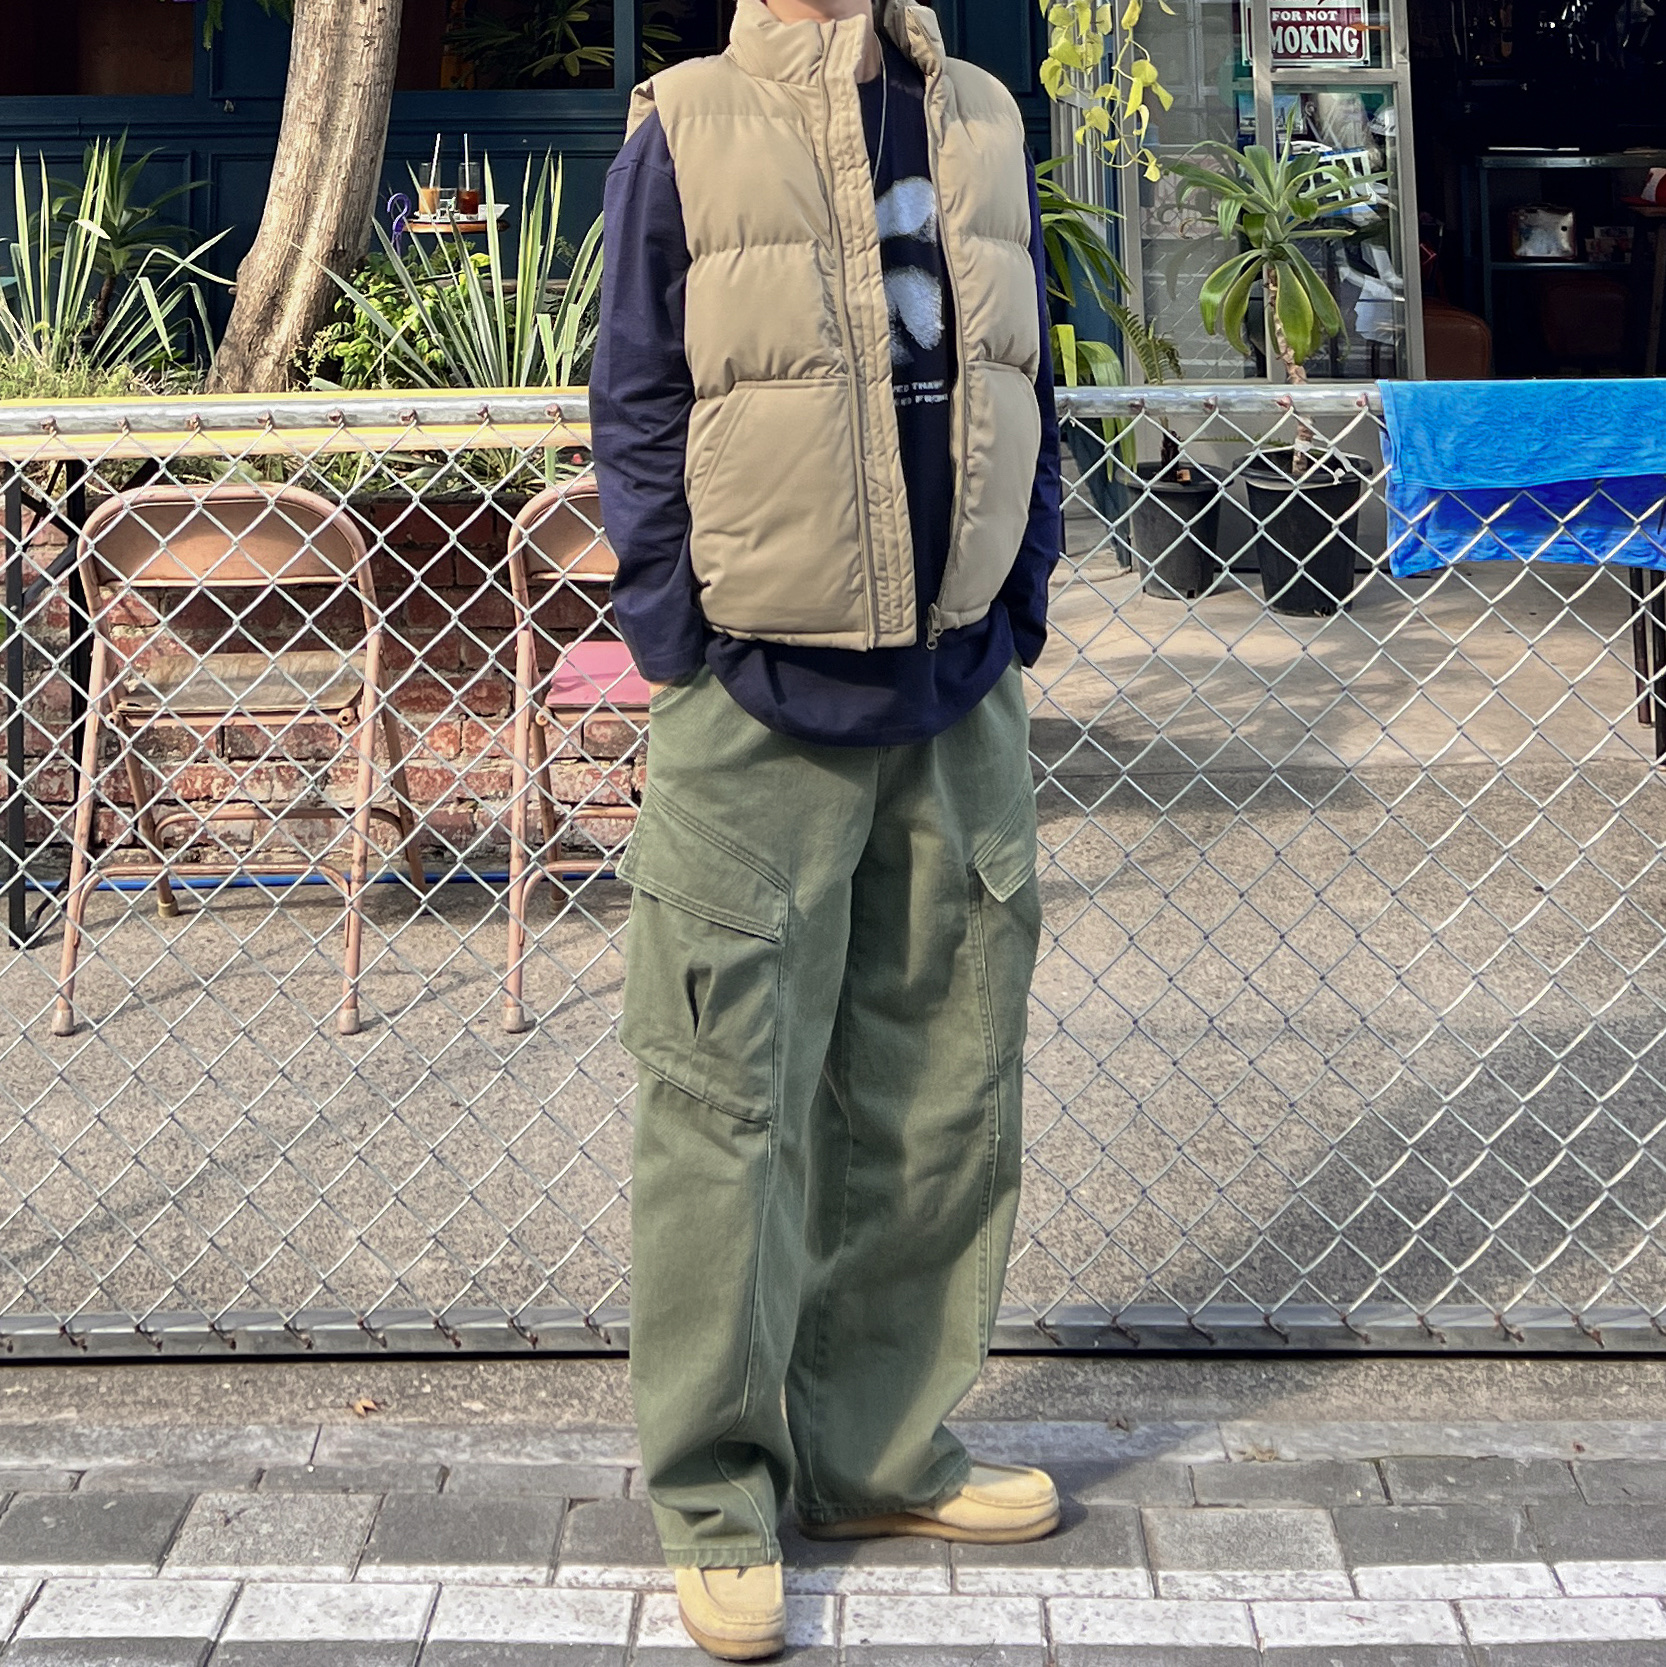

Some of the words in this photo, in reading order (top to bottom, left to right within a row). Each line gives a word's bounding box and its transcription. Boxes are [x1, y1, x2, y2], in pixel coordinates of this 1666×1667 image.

[1271, 10, 1302, 21] FOR
[1305, 10, 1338, 21] NOT
[1271, 25, 1360, 54] MOKING
